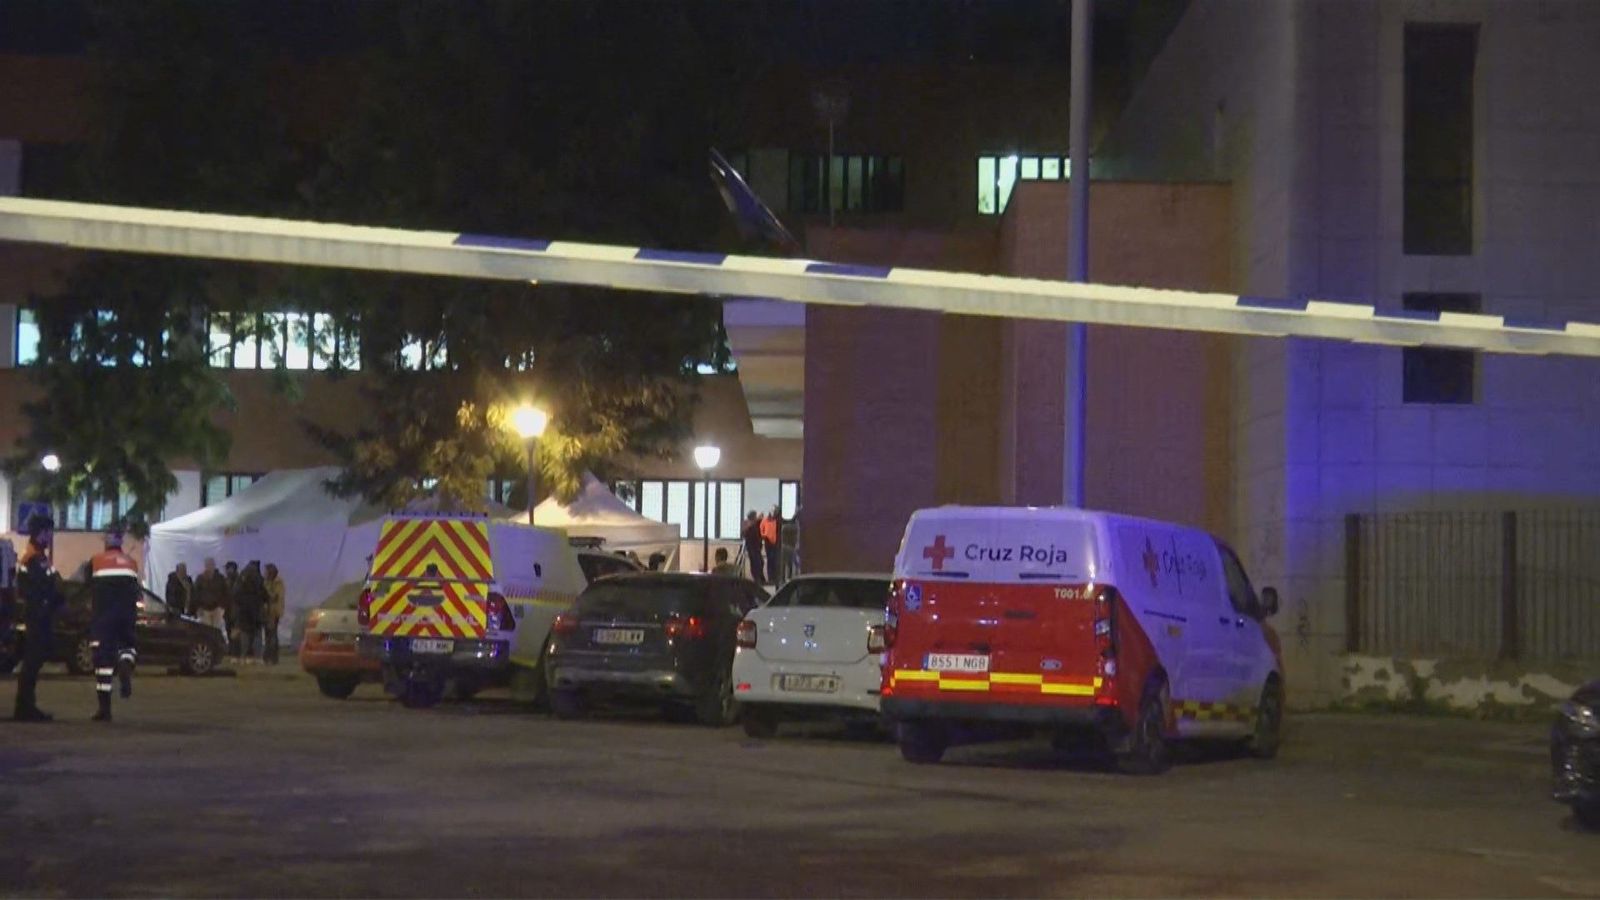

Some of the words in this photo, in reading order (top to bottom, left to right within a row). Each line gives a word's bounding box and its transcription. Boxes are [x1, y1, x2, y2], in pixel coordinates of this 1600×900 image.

[964, 544, 1012, 561] Cruz
[1020, 544, 1067, 567] Roja
[931, 656, 959, 668] 8551
